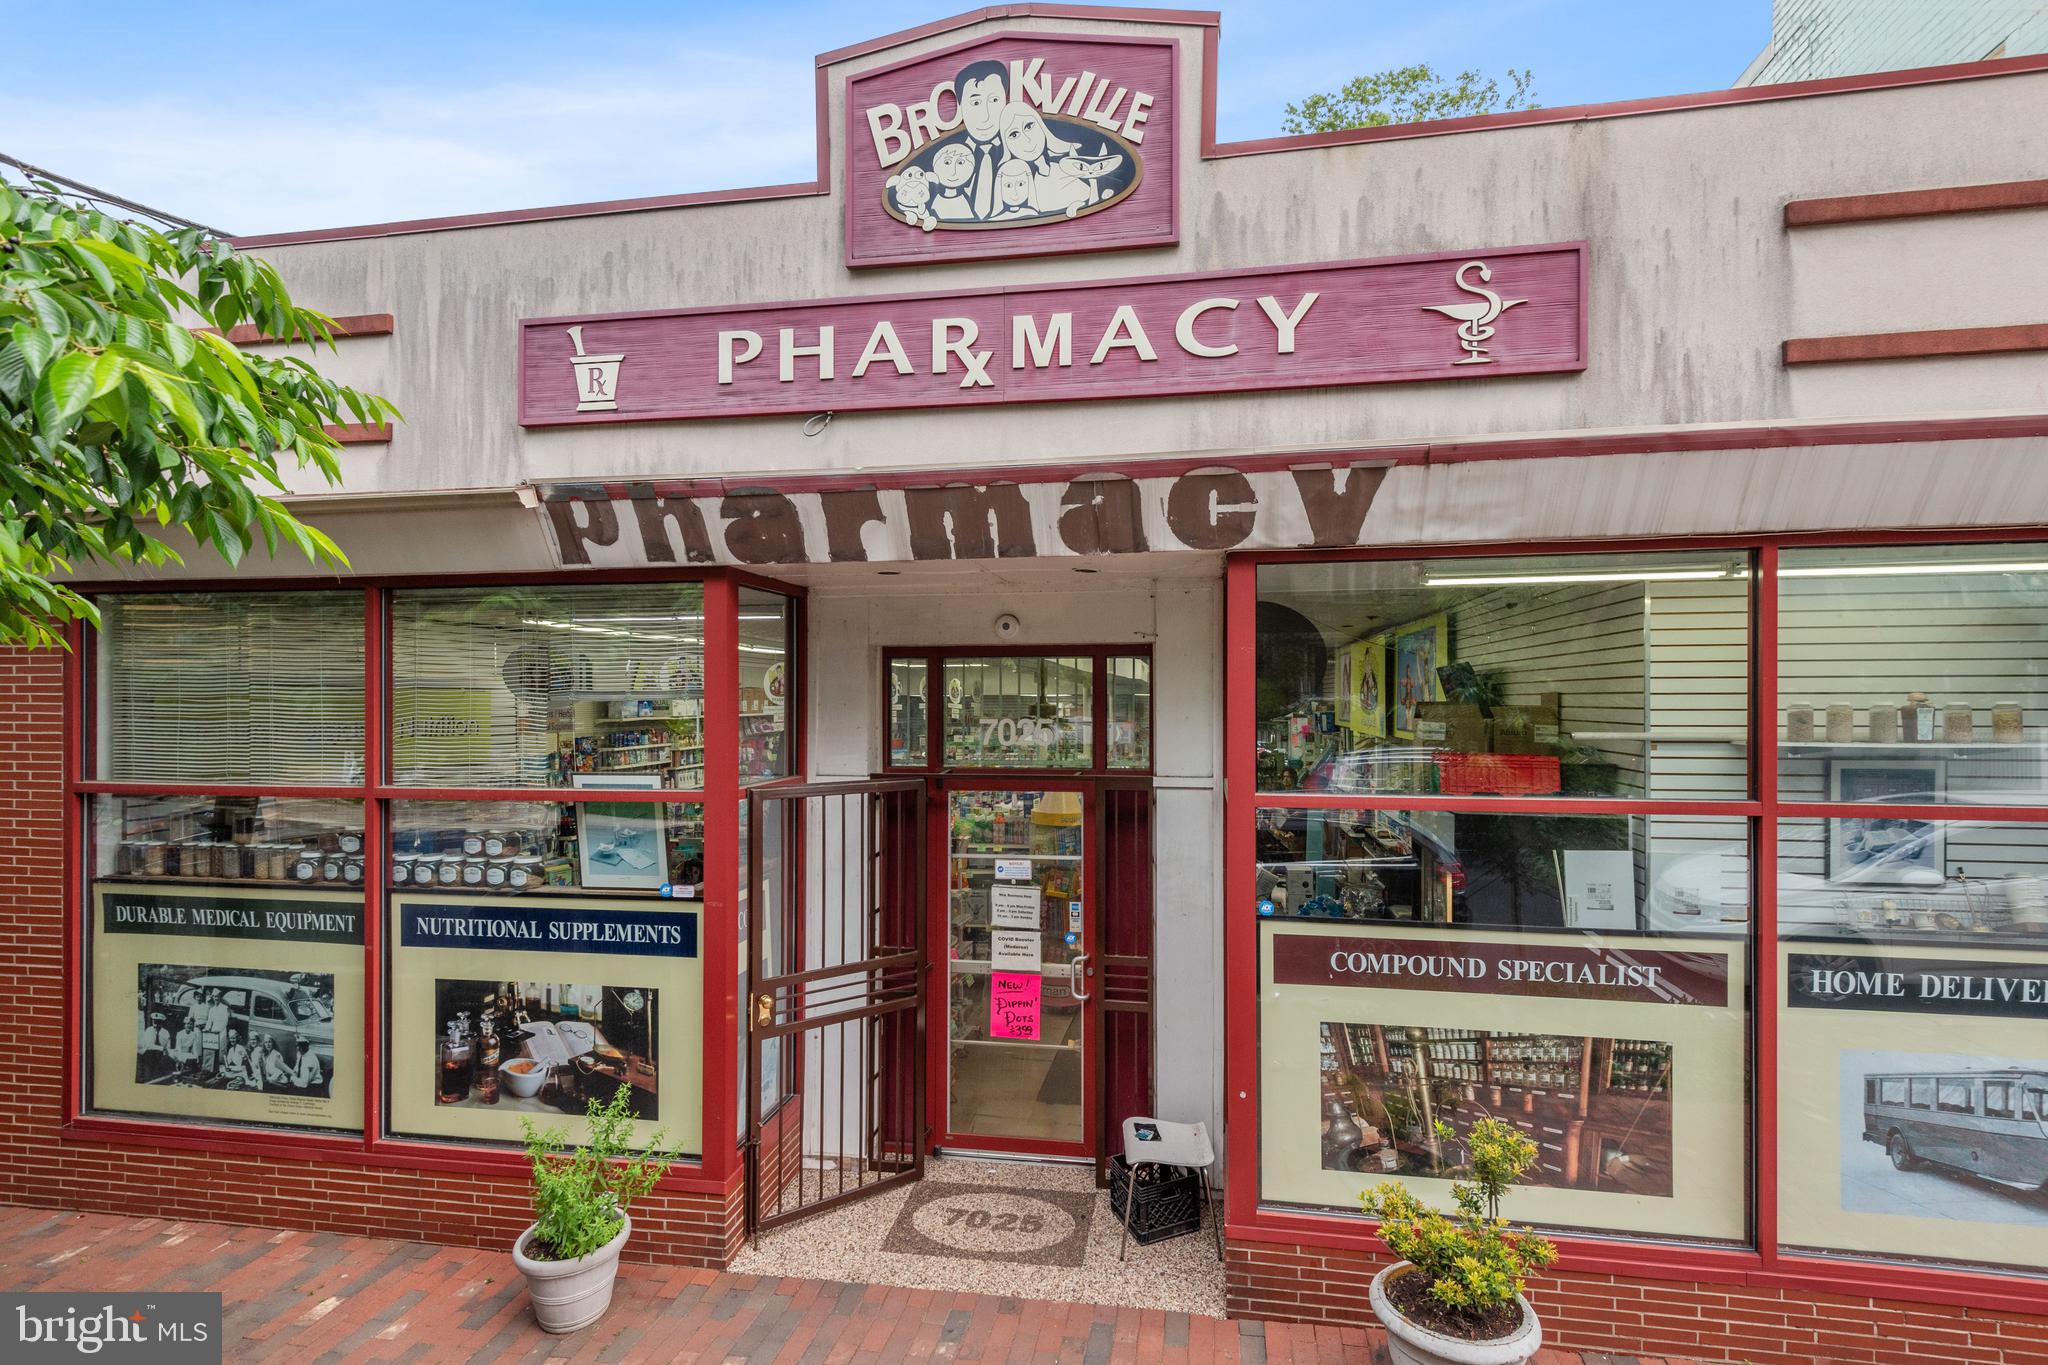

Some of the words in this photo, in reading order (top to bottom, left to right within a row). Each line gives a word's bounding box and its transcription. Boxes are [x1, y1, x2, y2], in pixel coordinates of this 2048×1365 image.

[978, 718, 1053, 747] 7025
[115, 904, 187, 926] DURABLE
[191, 907, 261, 930] MEDICAL
[265, 911, 357, 935] EQUIPMENT
[416, 917, 542, 940] NUTRITIONAL
[548, 921, 681, 945] SUPPLEMENTS
[1329, 950, 1487, 979] COMPOUND
[1497, 958, 1662, 989] SPECIALIST
[1809, 968, 1906, 998] HOME
[1919, 973, 2048, 1004] DELIVE
[945, 1206, 1046, 1234] 7025
